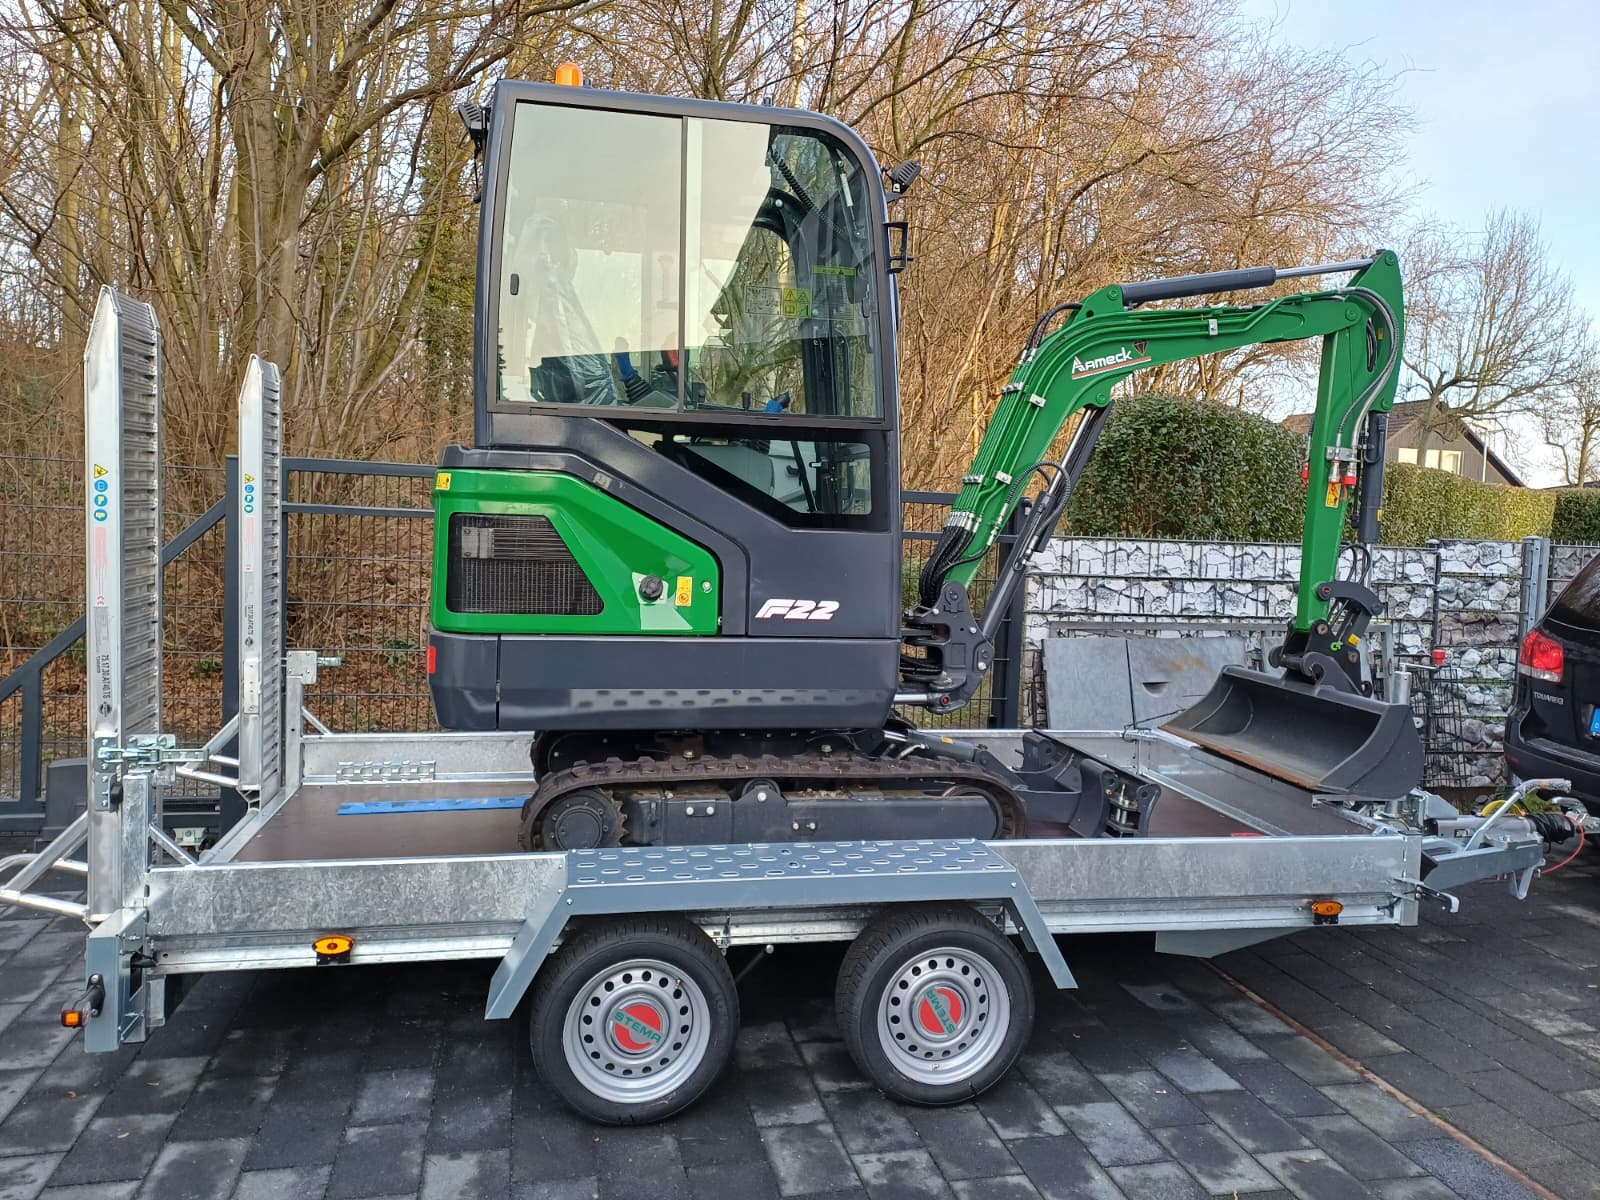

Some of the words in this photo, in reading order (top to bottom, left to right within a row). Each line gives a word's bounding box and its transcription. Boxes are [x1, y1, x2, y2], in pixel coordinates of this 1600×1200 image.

[754, 598, 840, 621] F22
[925, 986, 956, 1035] STEMA
[613, 1011, 663, 1044] STEMA
